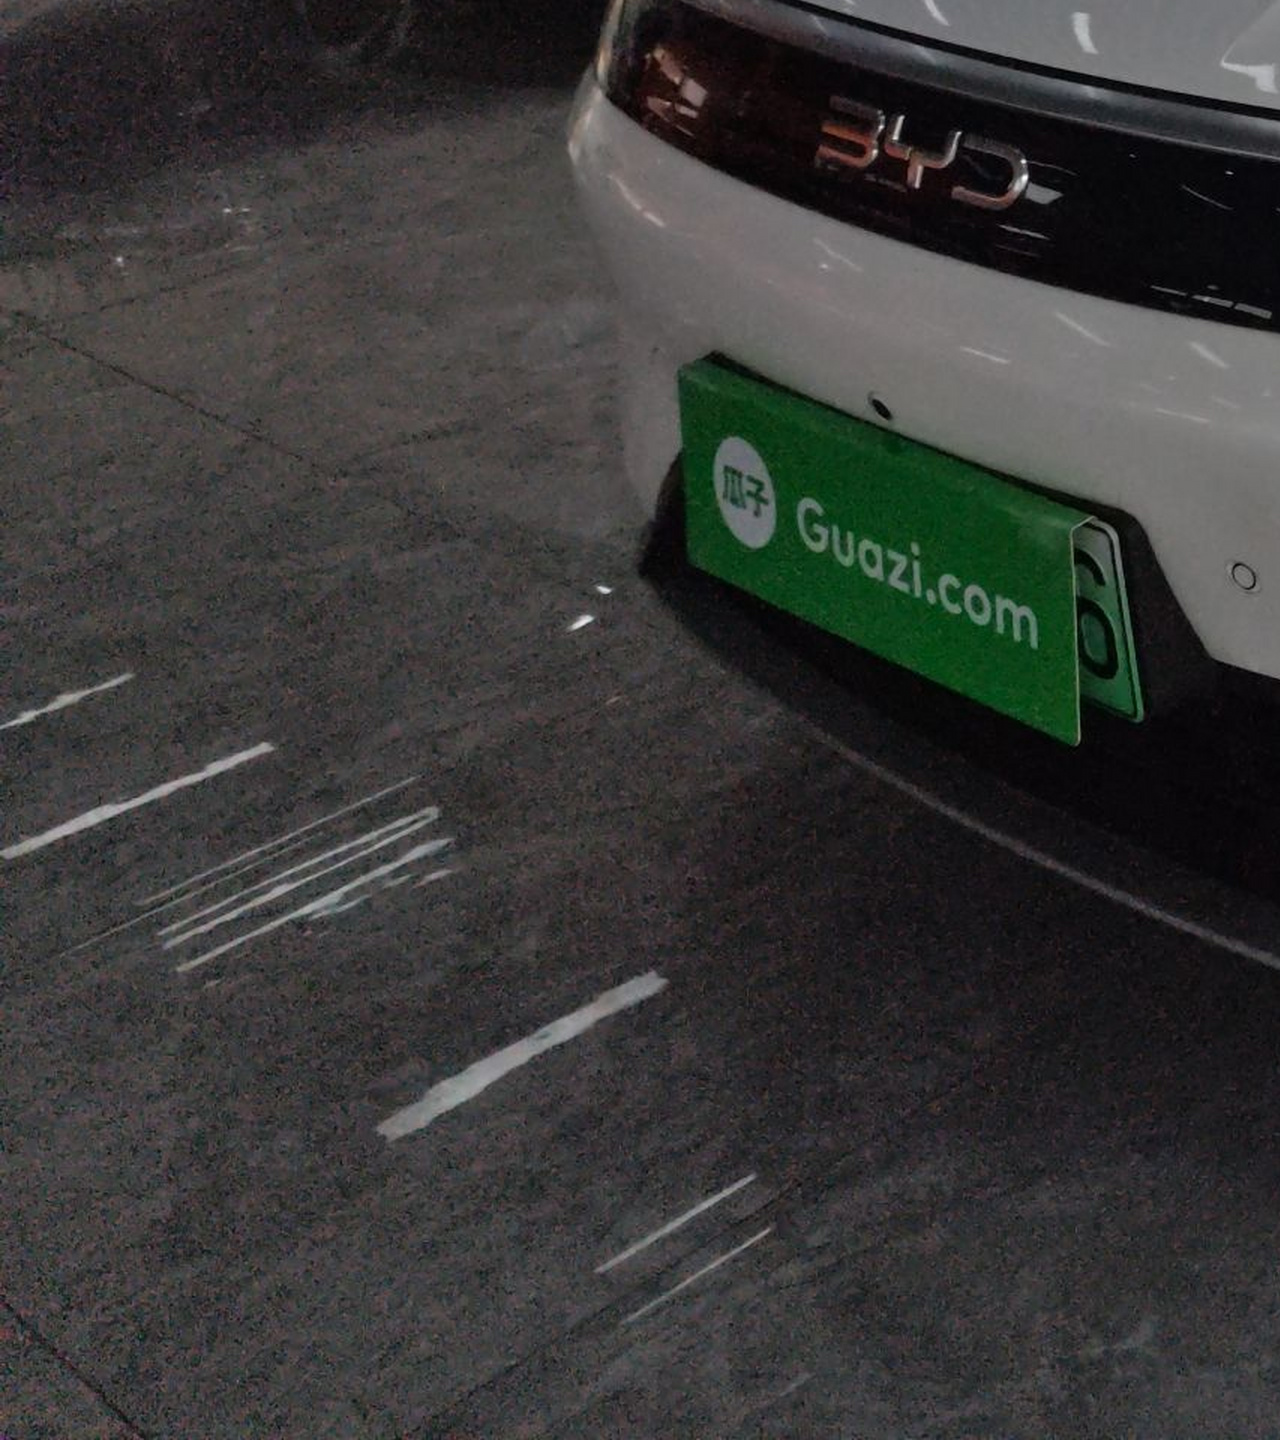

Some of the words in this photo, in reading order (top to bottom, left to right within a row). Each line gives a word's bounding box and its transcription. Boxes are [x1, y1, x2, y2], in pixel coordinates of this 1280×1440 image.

[814, 94, 1029, 211] BYD
[722, 464, 770, 518] 瓜子
[796, 496, 1039, 650] Guazi.com
